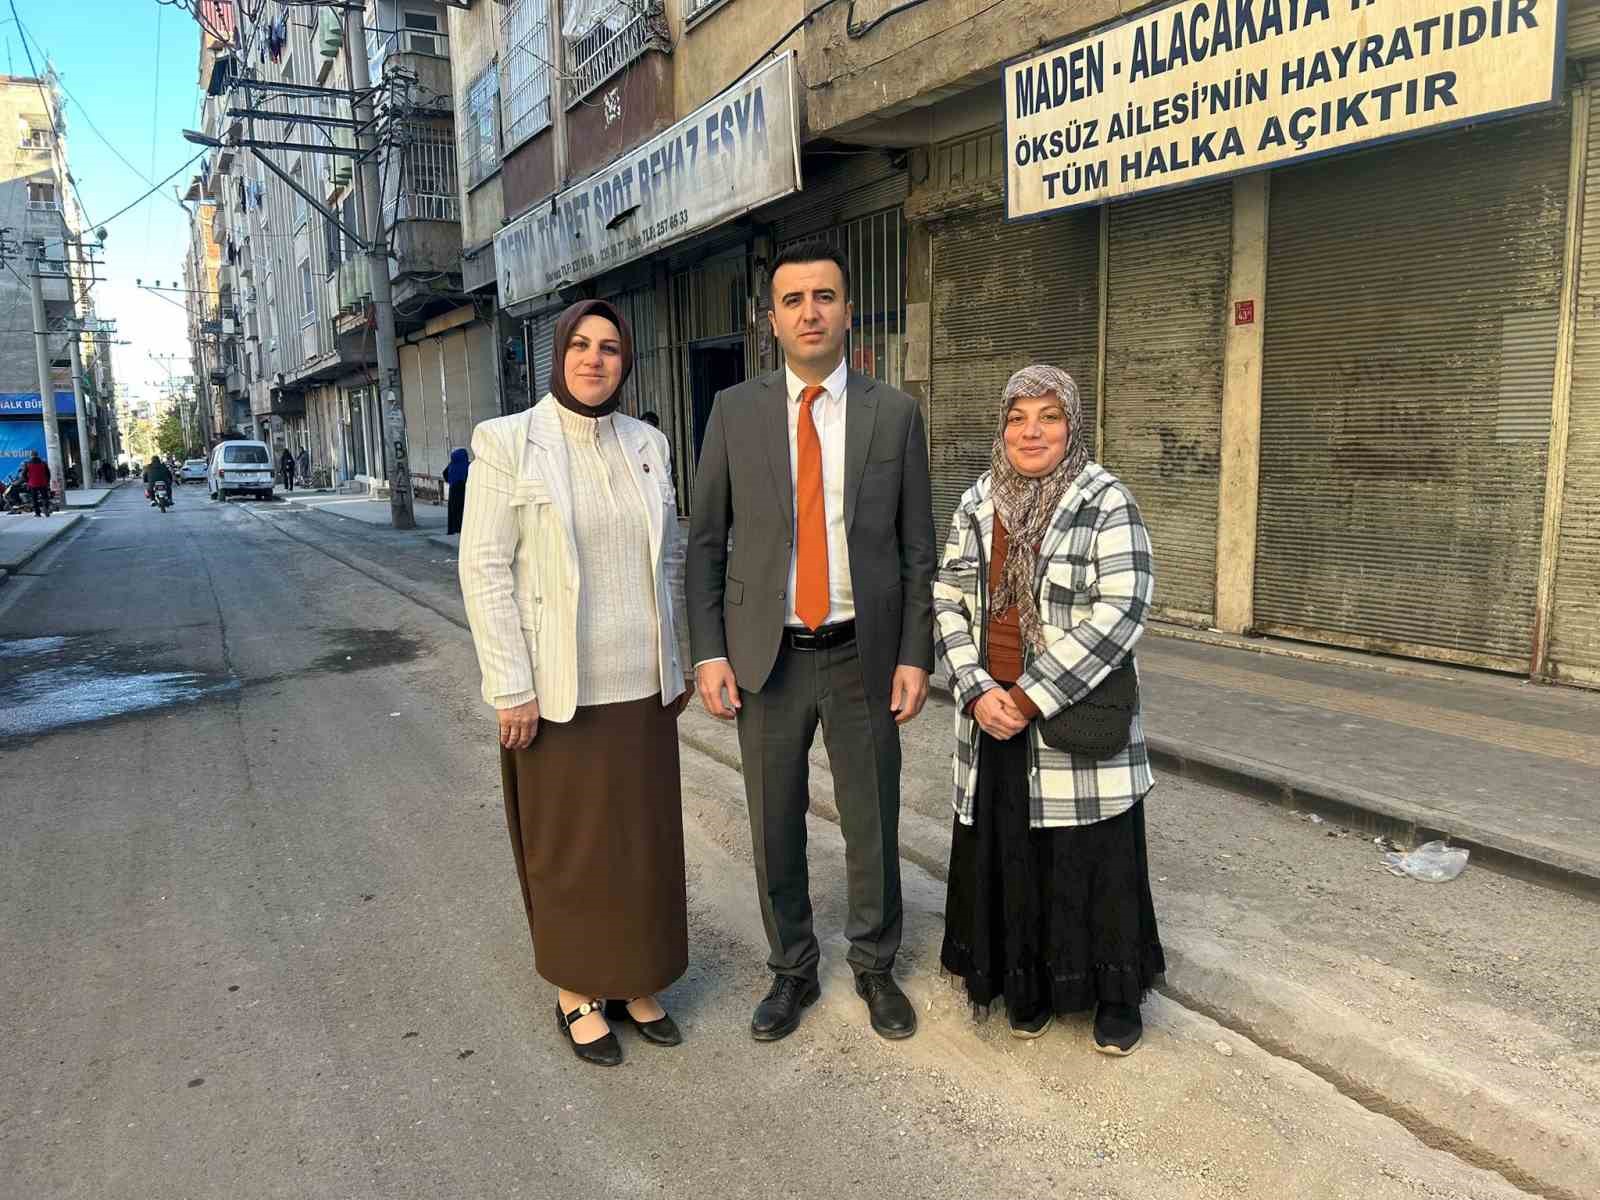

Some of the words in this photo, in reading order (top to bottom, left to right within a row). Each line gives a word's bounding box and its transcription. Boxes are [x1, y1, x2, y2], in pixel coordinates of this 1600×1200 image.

[1015, 41, 1104, 119] MADEN
[1015, 119, 1099, 167] ÖKSÜZ
[1281, 0, 1539, 96] HAYRATIDIR
[1042, 160, 1109, 200] TÜM
[1120, 126, 1245, 183] HALKA
[1257, 70, 1458, 151] AÇIKTIR
